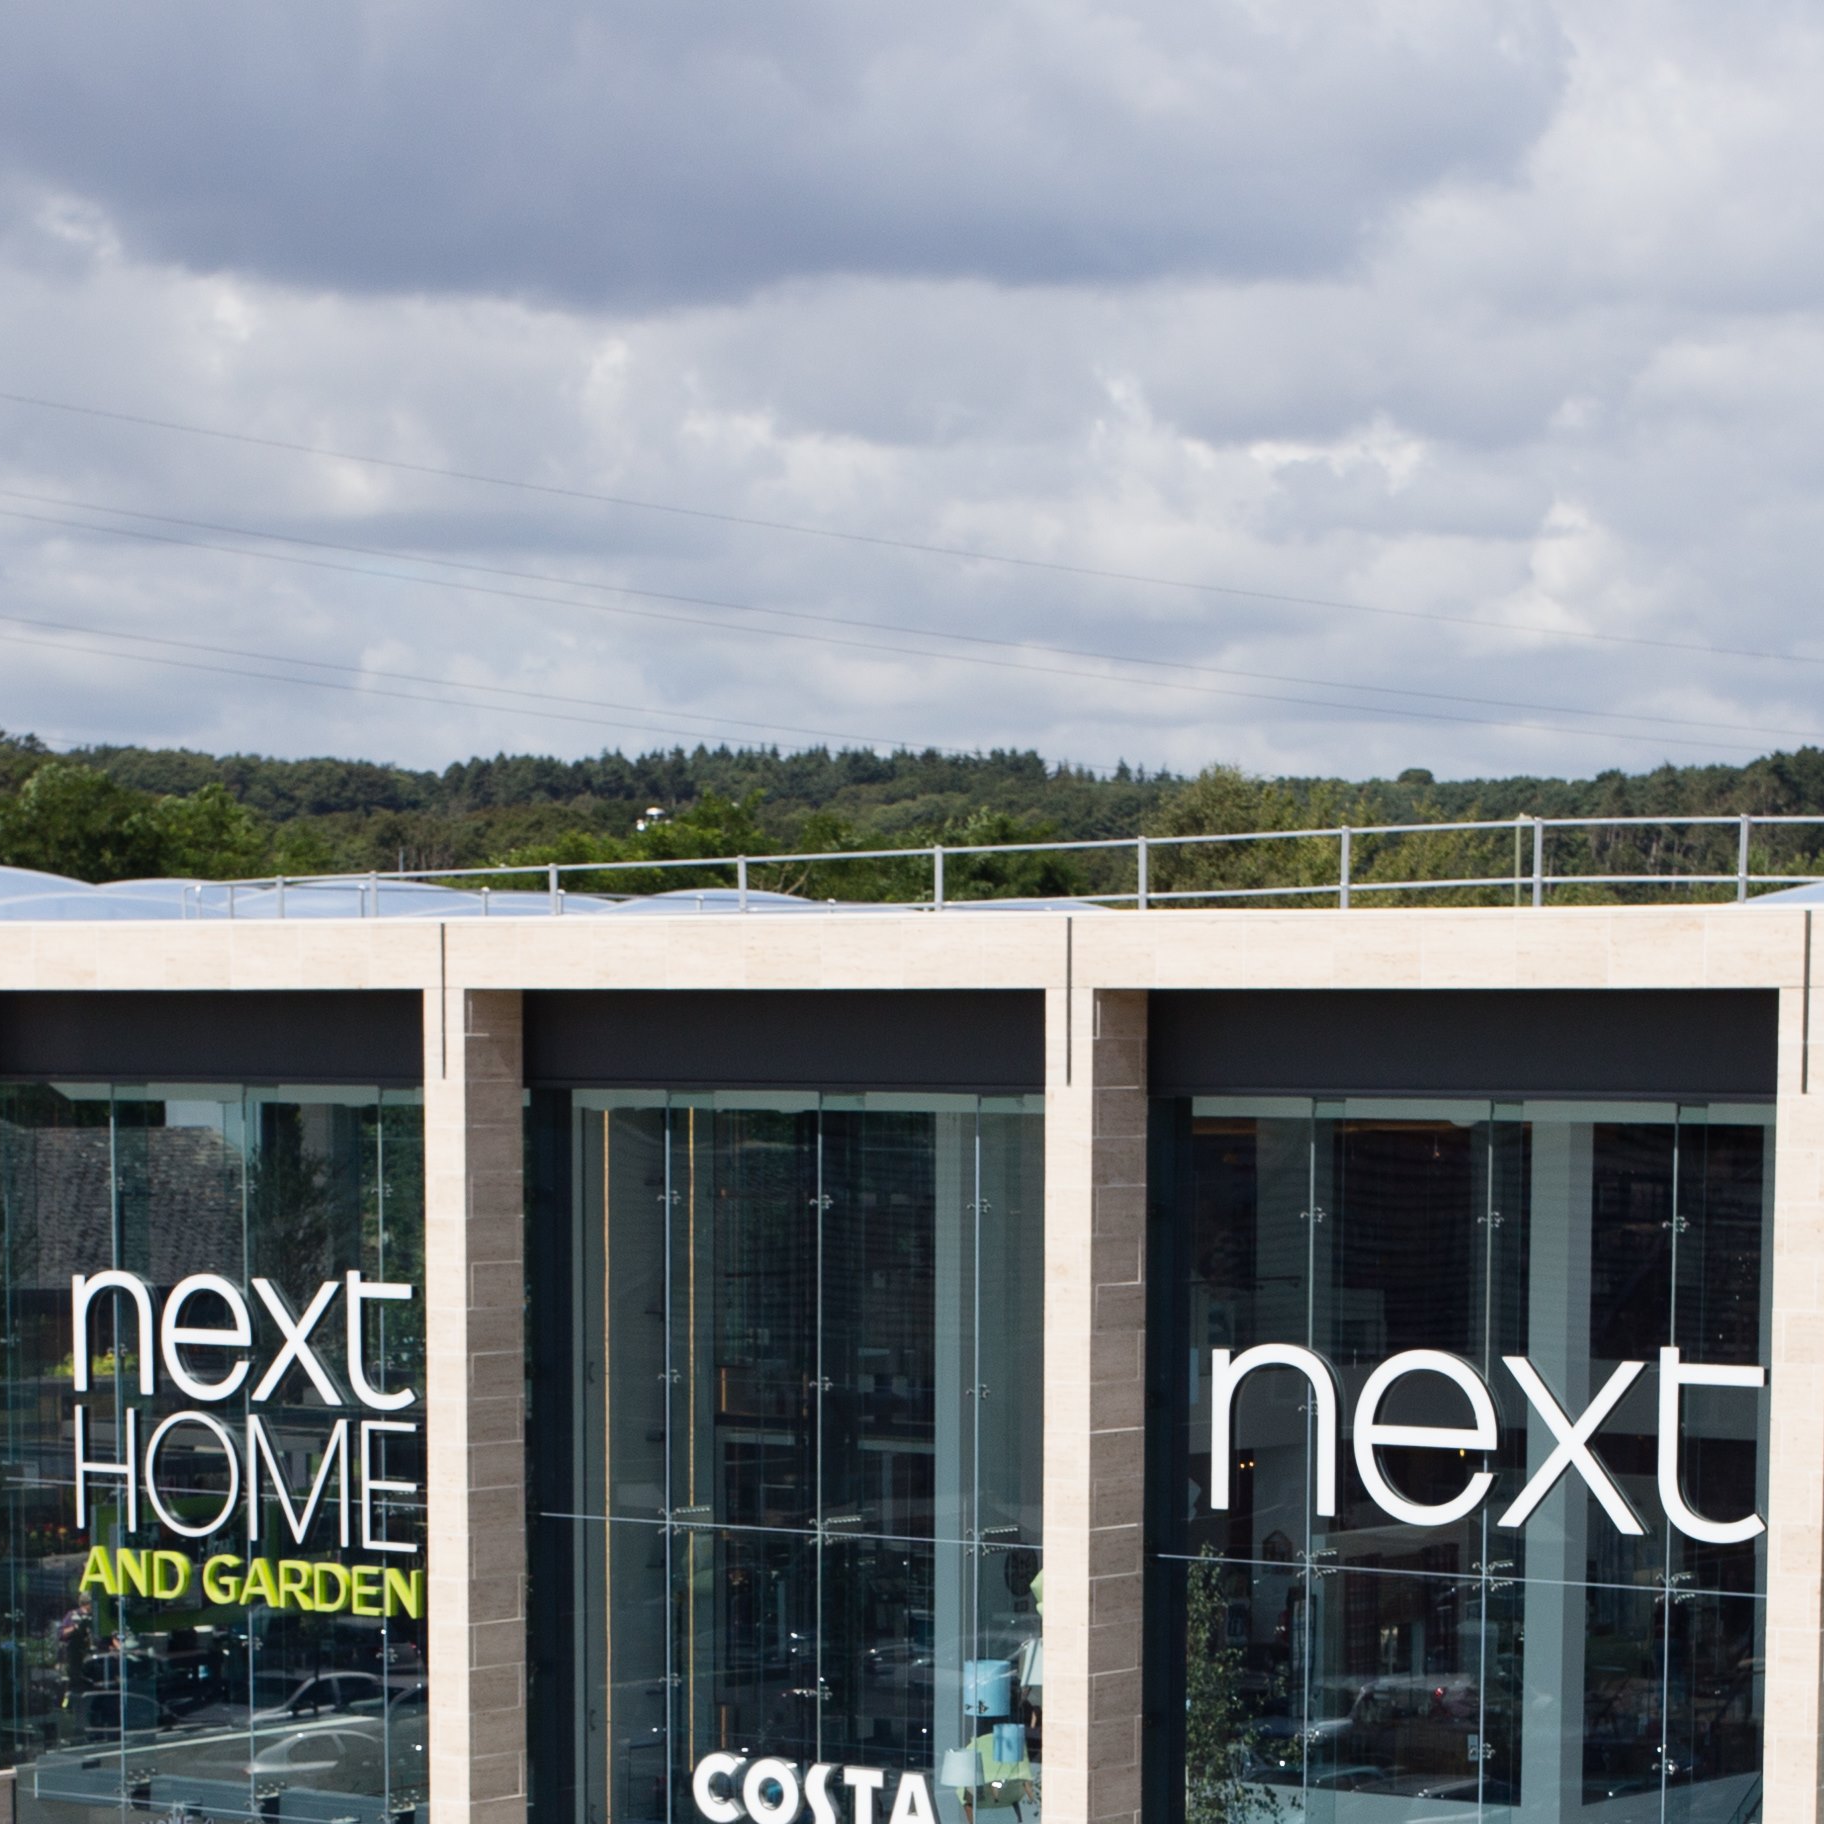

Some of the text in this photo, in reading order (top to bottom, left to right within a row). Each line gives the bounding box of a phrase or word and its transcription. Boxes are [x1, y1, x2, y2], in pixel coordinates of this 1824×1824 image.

[71, 1270, 416, 1412] next
[71, 1404, 418, 1553] HOME
[1210, 1343, 1767, 1545] next
[79, 1544, 425, 1619] AND GARDEN
